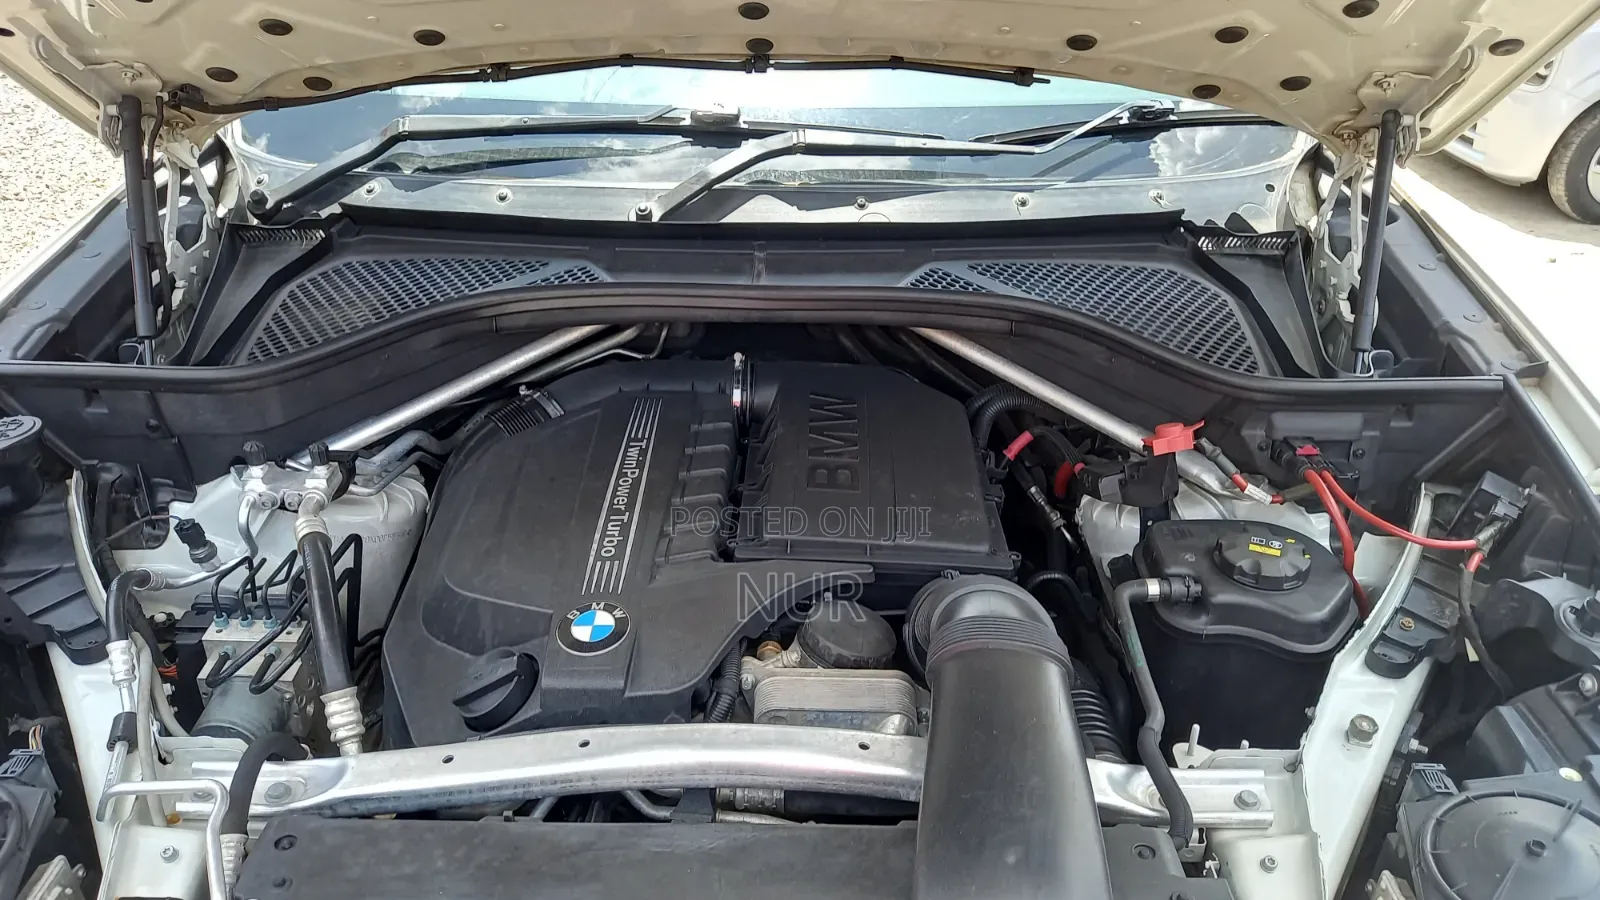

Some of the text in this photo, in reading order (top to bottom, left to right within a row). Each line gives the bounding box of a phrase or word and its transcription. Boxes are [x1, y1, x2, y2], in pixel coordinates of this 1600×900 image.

[807, 392, 861, 493] BMW
[600, 439, 647, 557] TwinPower Turbo
[566, 602, 627, 620] BMW
